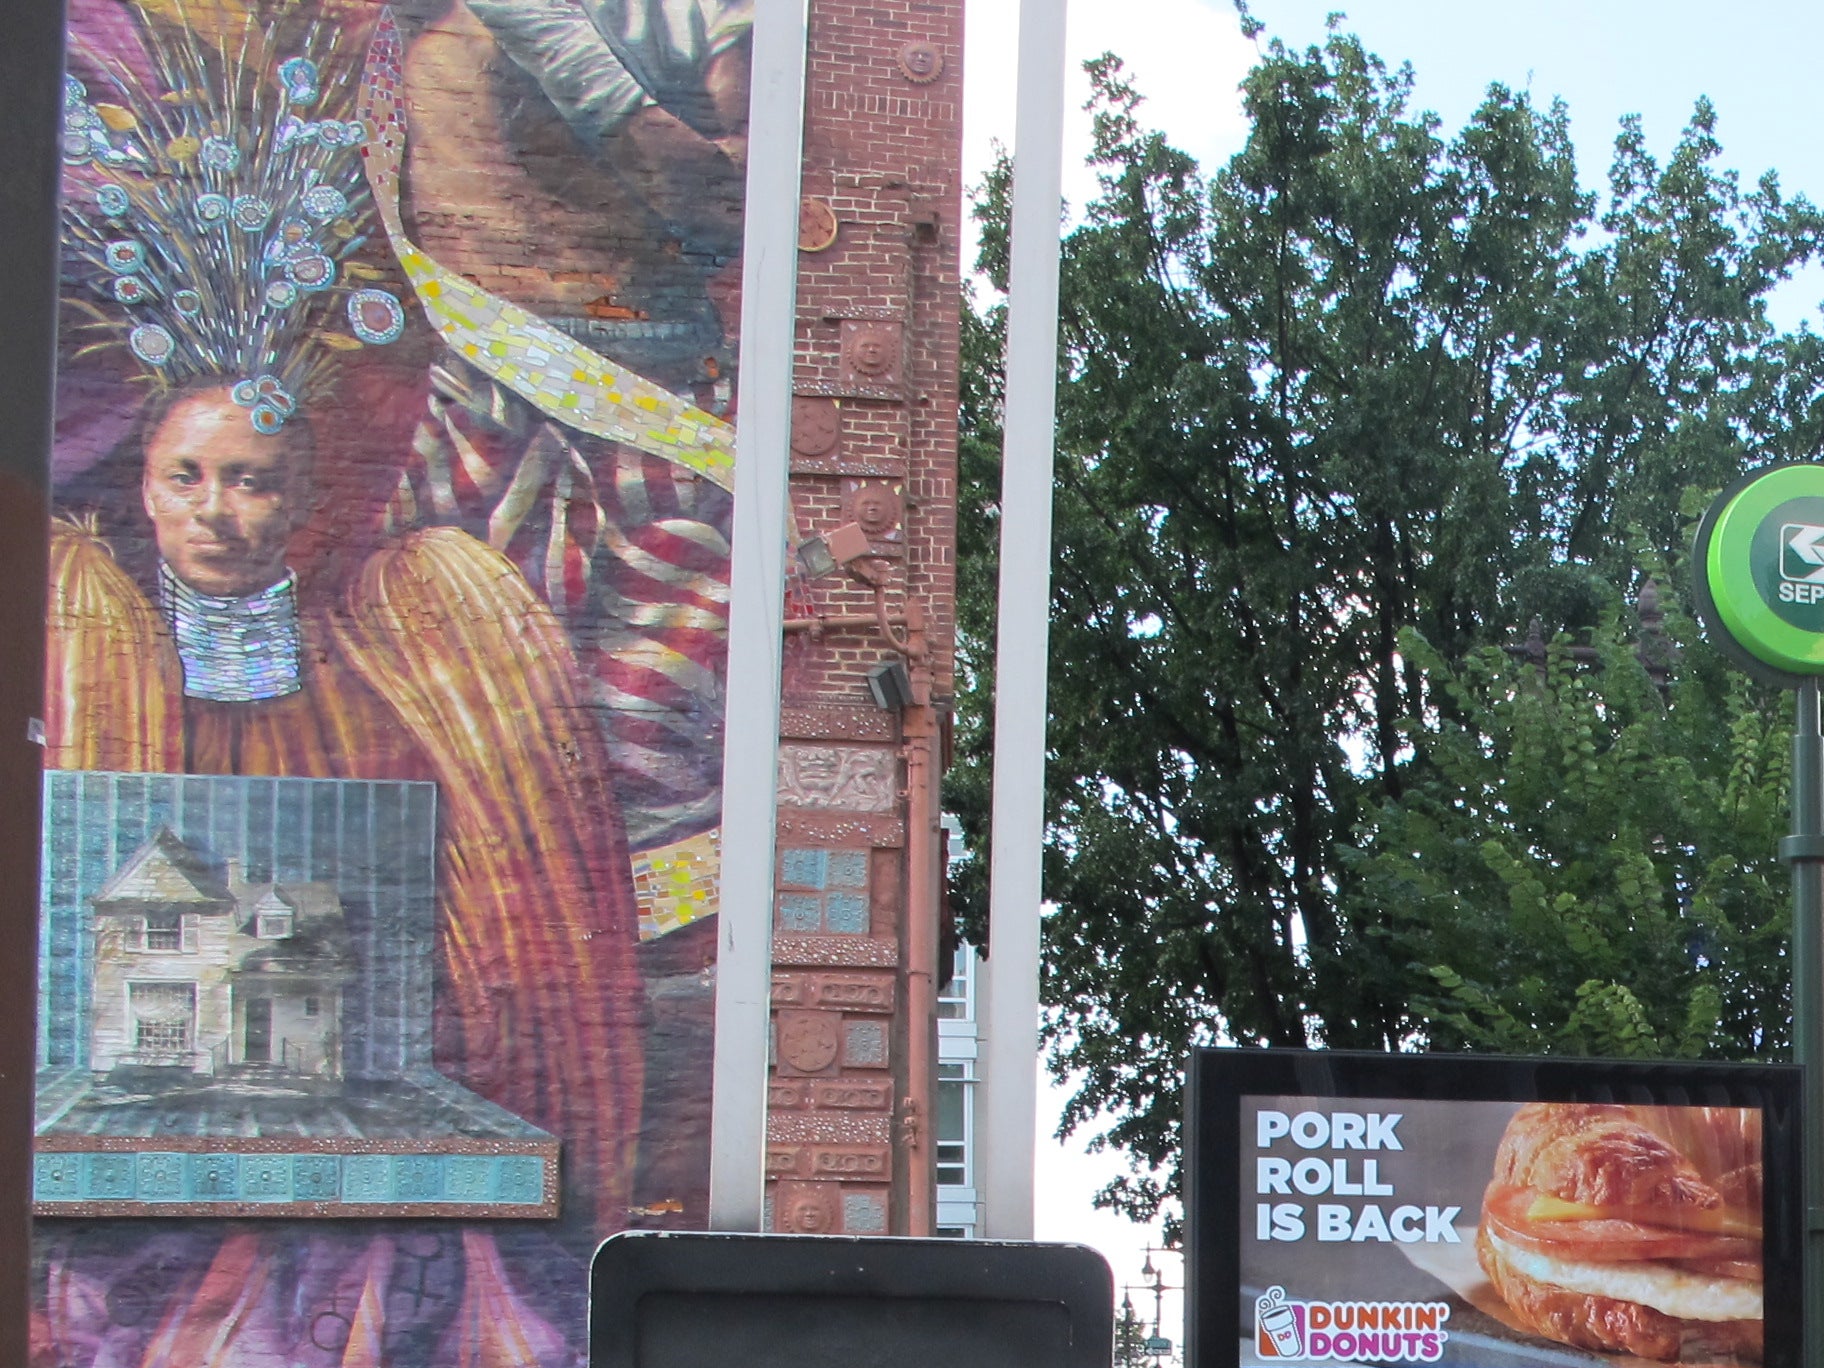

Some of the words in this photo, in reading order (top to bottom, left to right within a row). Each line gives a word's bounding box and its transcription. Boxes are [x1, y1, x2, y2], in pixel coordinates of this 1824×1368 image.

[1256, 1110, 1404, 1151] PORK
[1256, 1157, 1394, 1196] ROLL
[1256, 1203, 1306, 1242] IS
[1317, 1203, 1462, 1243] BACK
[1309, 1305, 1446, 1330] DUNKIN'
[1309, 1332, 1440, 1358] DONUTS
